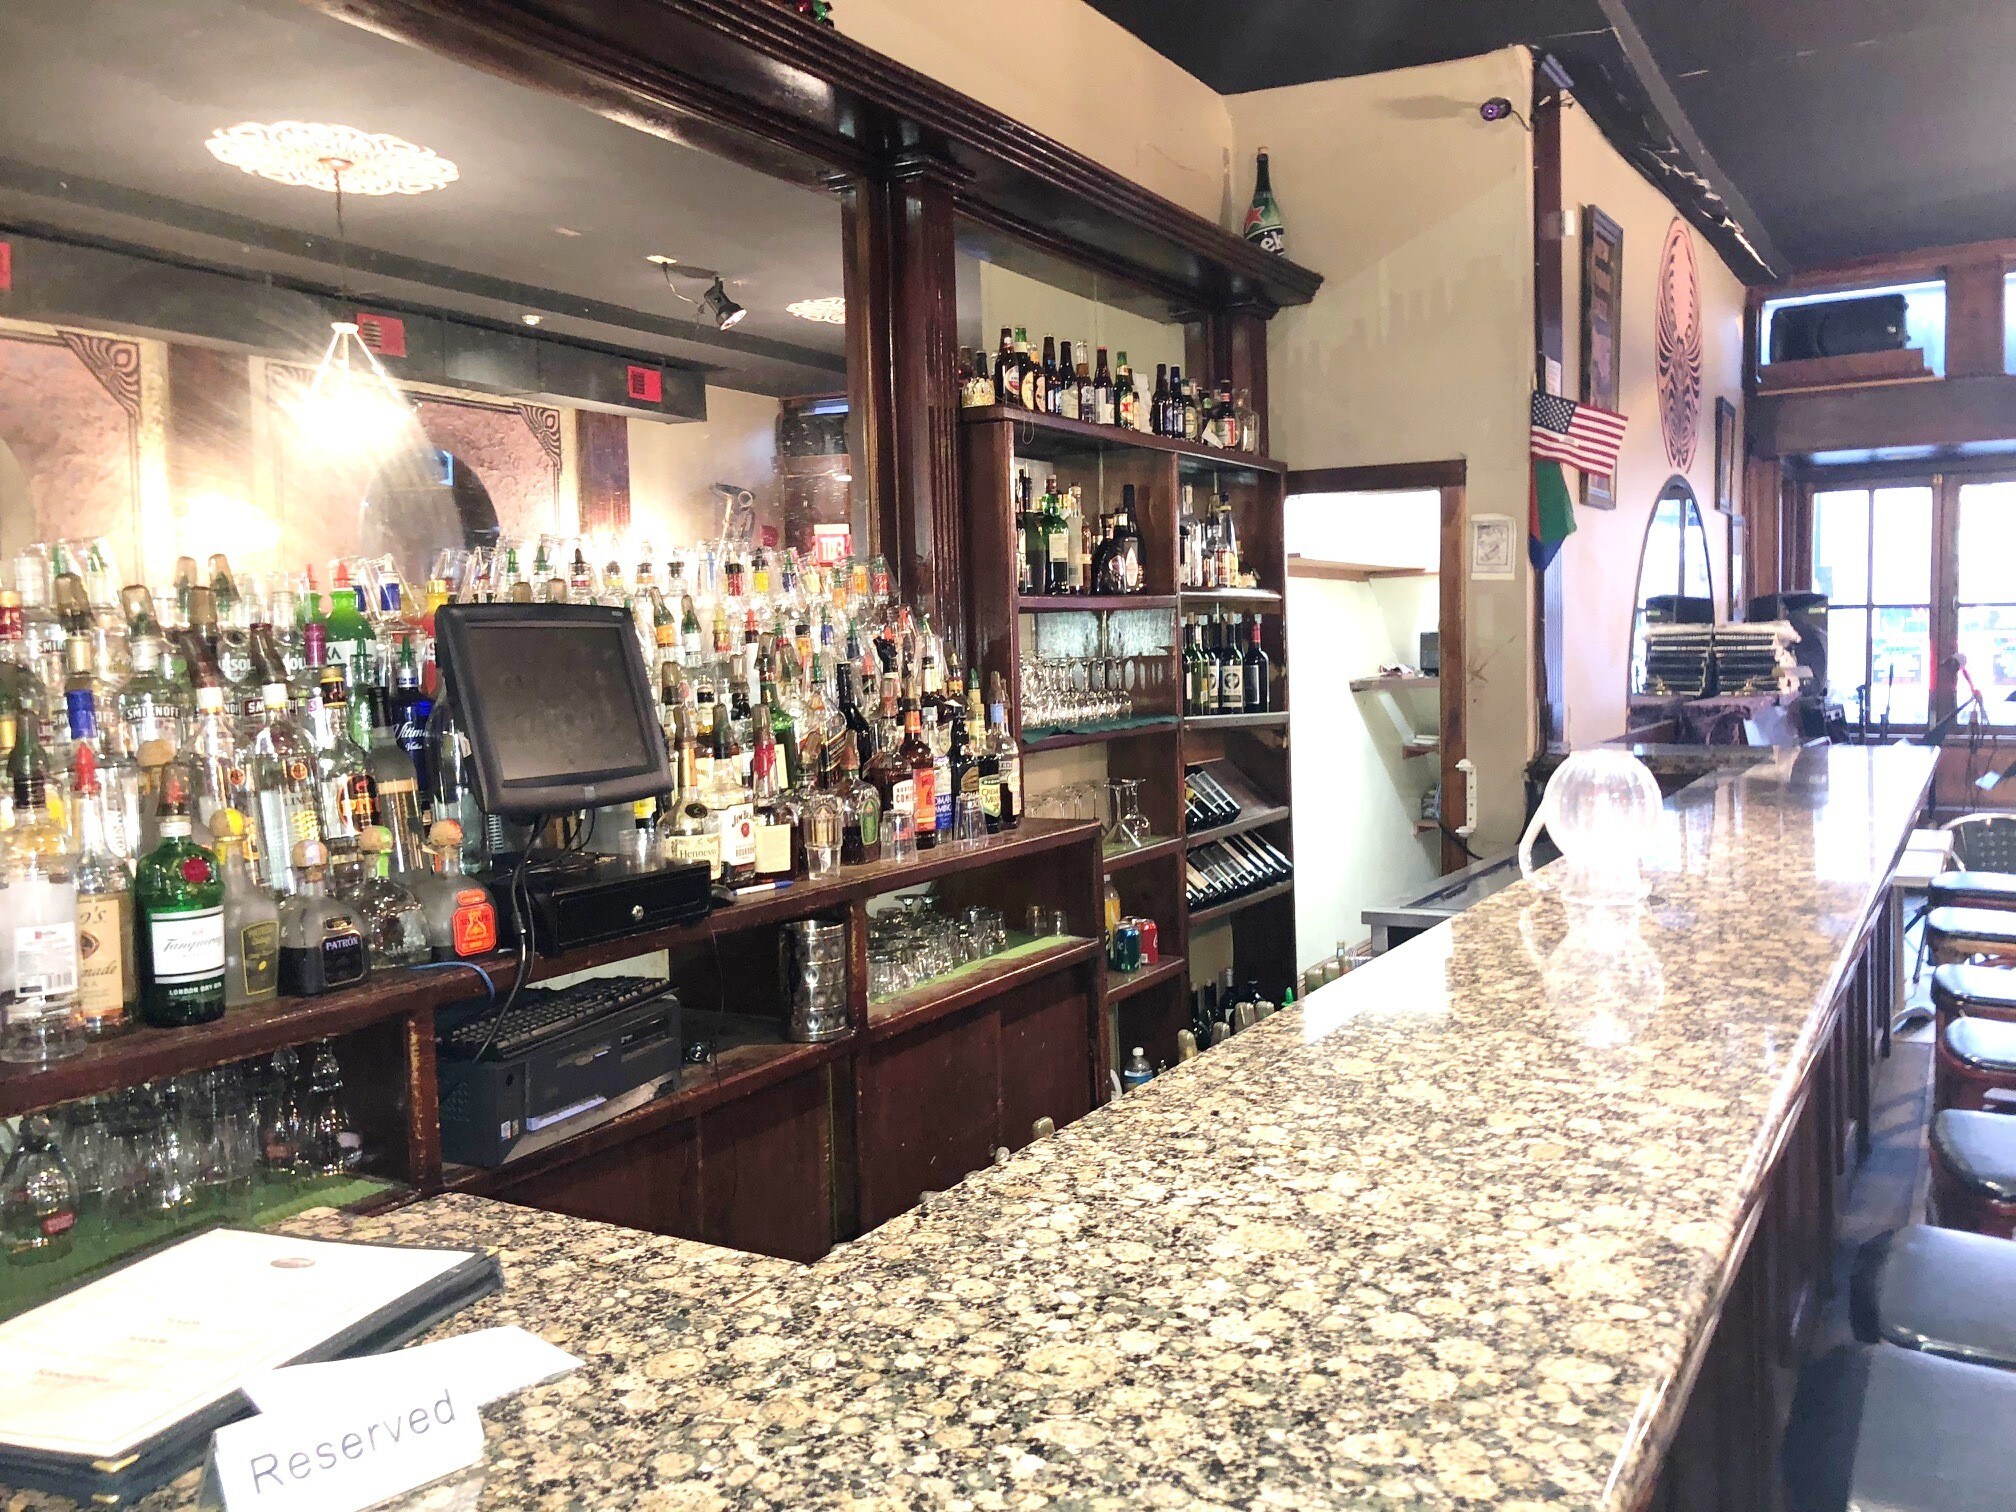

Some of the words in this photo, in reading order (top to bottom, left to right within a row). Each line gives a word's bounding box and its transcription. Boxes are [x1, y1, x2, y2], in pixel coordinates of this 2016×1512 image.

[126, 706, 179, 720] SMINOFF
[394, 722, 431, 739] Ultima
[250, 1388, 456, 1495] Reserved
